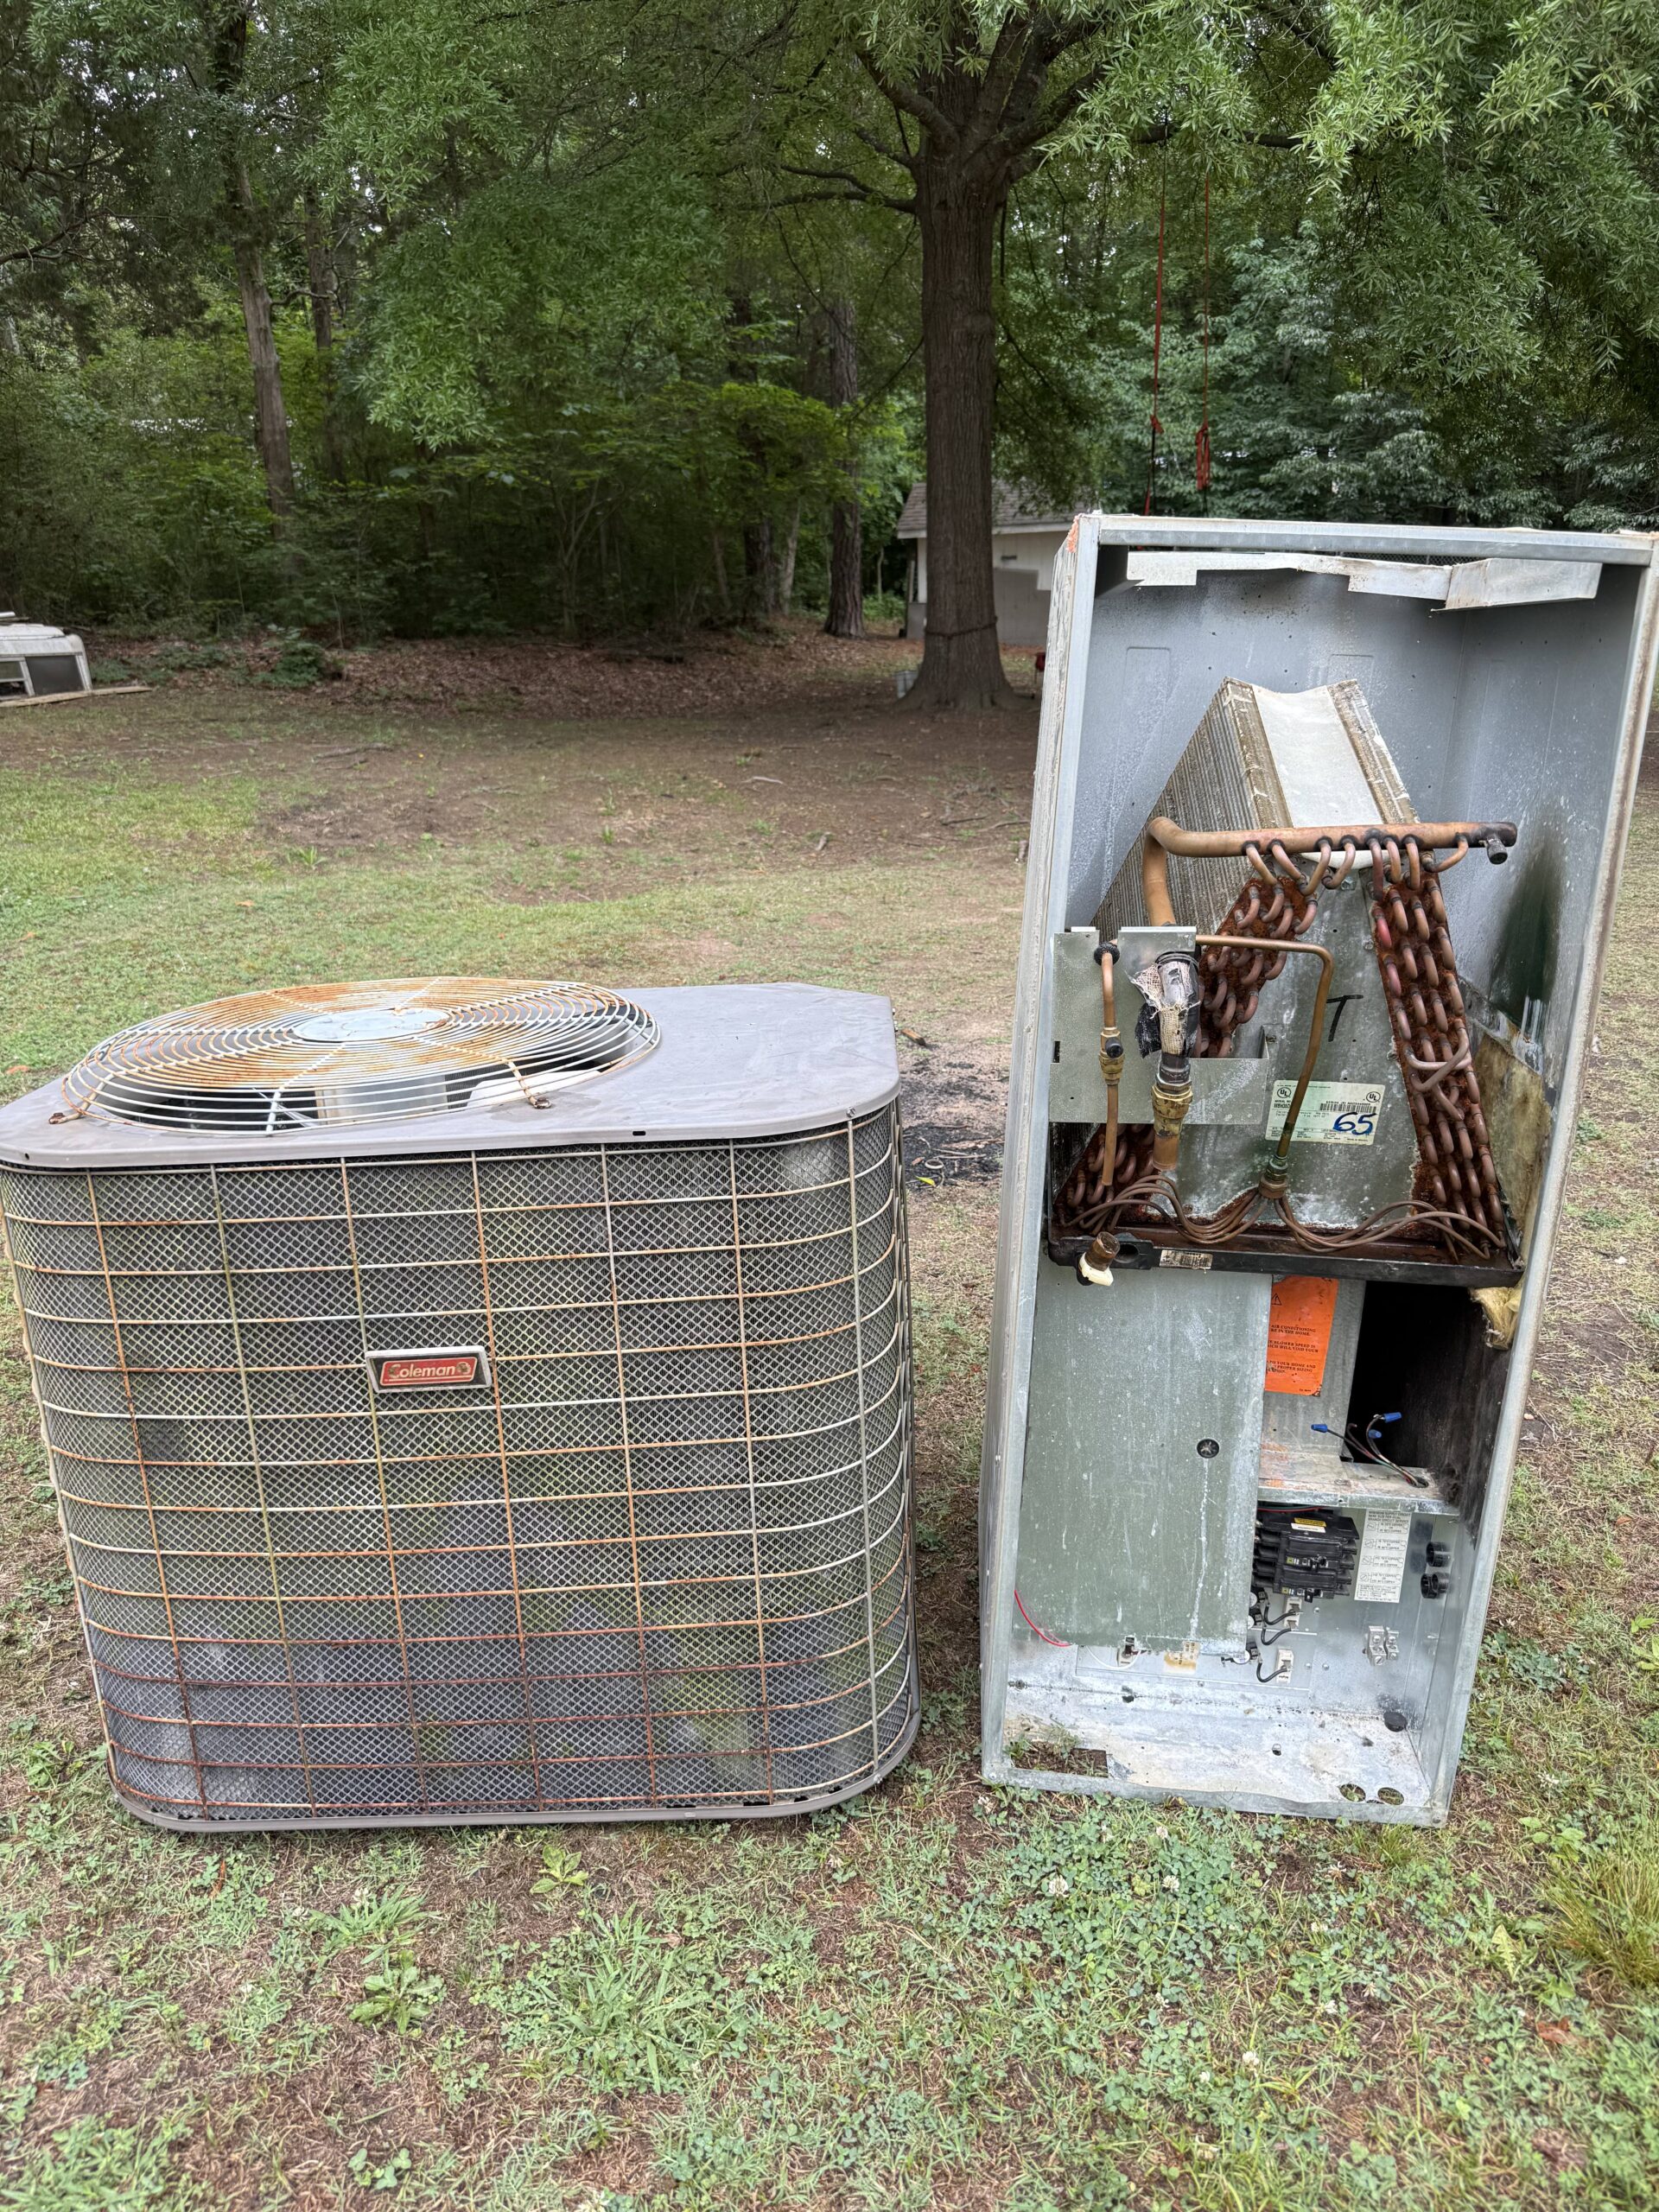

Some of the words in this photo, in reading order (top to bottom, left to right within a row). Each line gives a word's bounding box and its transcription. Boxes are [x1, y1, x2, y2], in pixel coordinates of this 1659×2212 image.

[1325, 995, 1363, 1042] T
[1332, 1112, 1377, 1135] 65
[387, 1363, 455, 1379] Coleman
